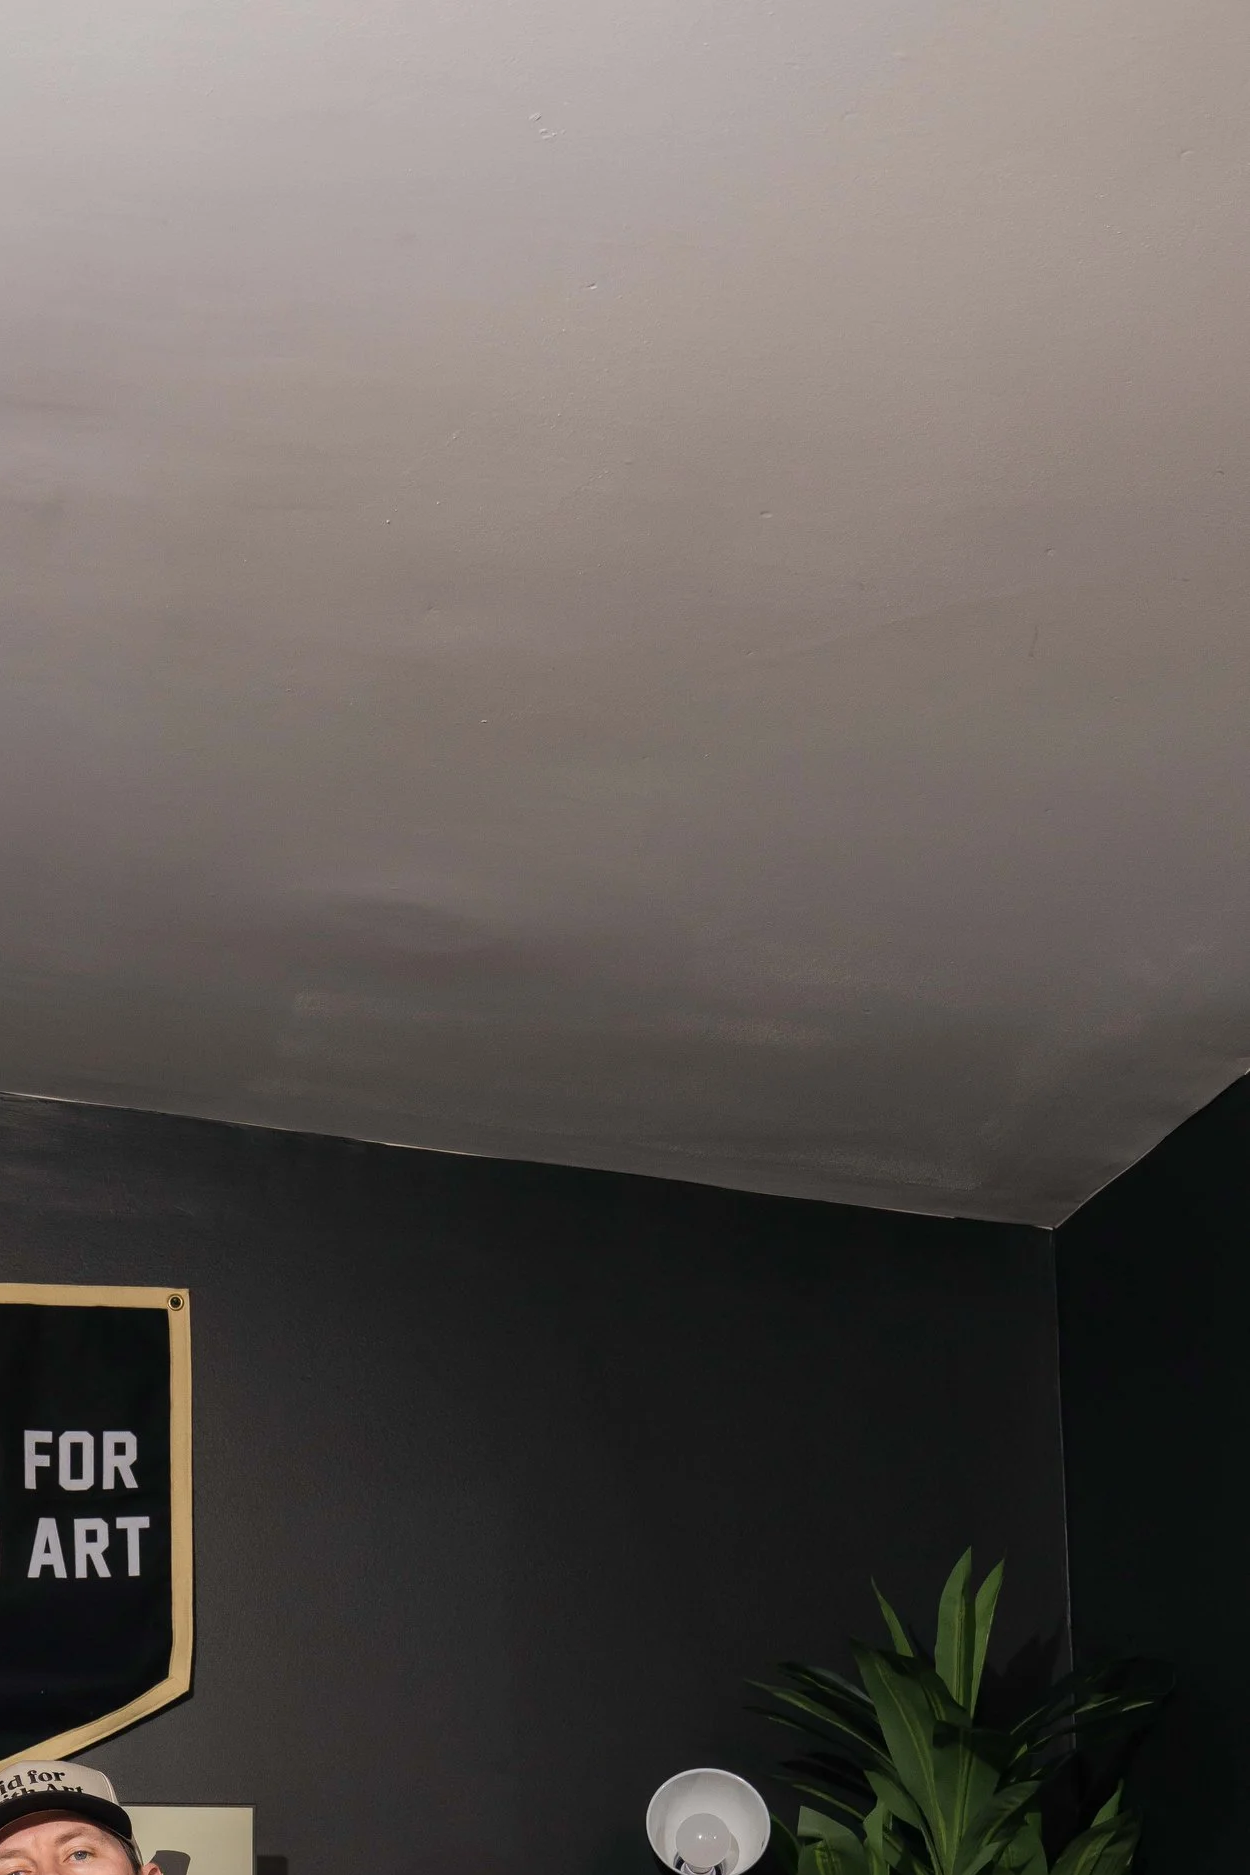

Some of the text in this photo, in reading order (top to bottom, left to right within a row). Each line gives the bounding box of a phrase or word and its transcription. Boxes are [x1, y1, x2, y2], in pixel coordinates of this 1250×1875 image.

[24, 1430, 138, 1491] FOR
[27, 1516, 150, 1579] ART
[27, 1769, 65, 1785] for
